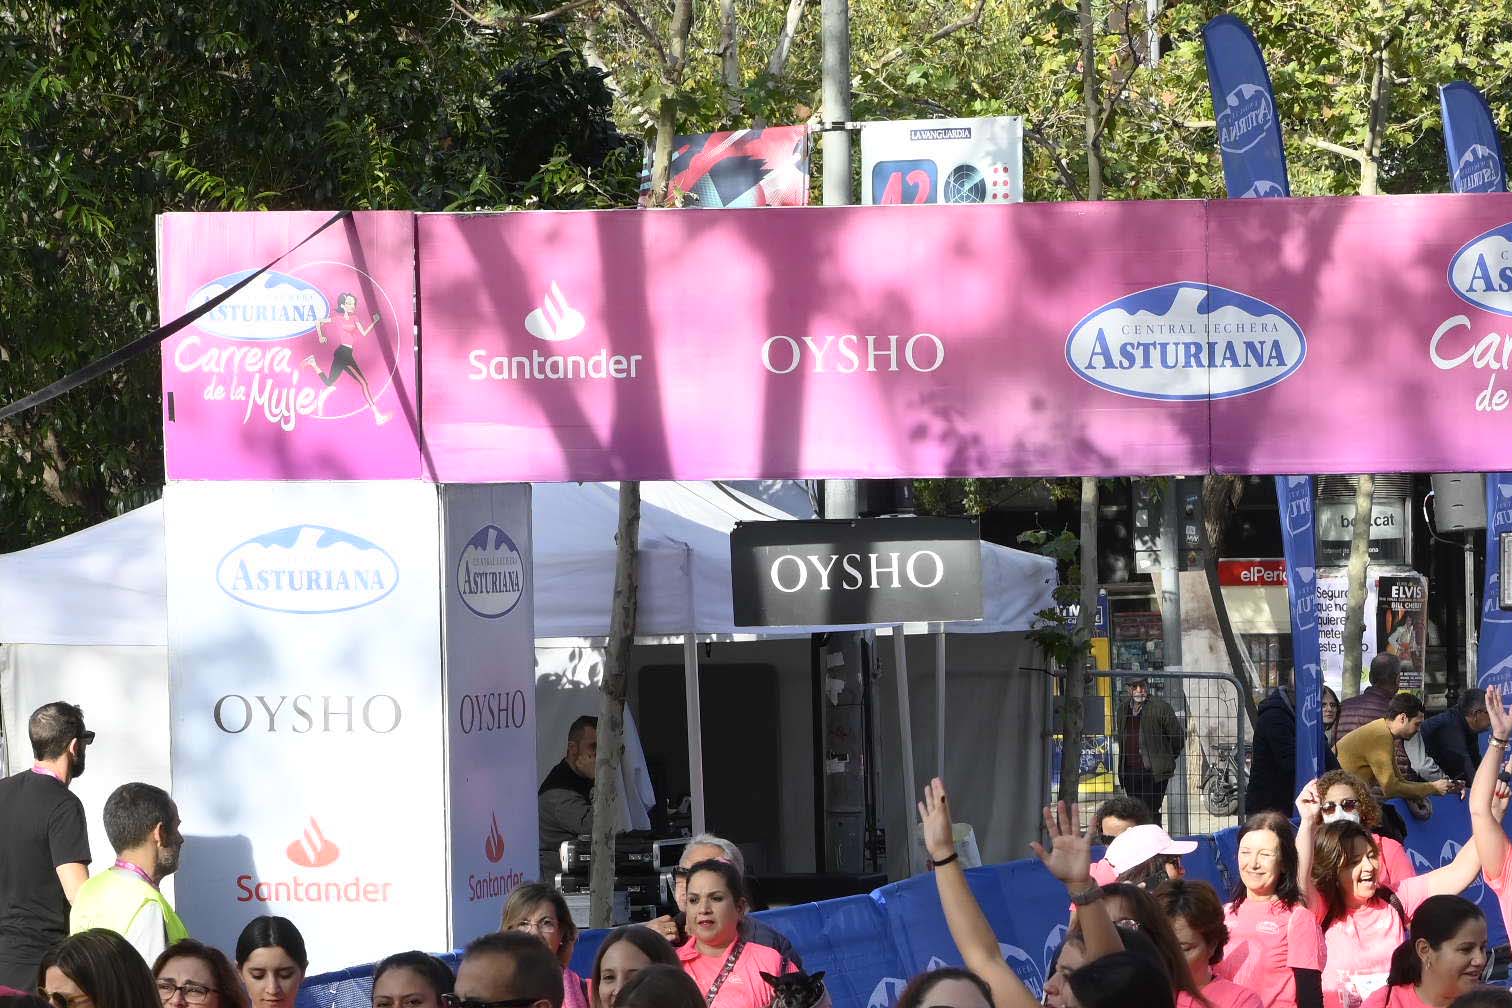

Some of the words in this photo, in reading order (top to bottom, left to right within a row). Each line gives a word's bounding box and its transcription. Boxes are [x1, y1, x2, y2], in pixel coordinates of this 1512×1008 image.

[922, 129, 971, 140] VANGUARDIA
[1122, 321, 1199, 335] CENTRAL
[1205, 320, 1279, 334] LECHERA
[174, 337, 292, 374] Carrera
[469, 349, 642, 380] Santander
[761, 333, 945, 374] OYSHO
[1086, 326, 1287, 370] ASTURIANA
[203, 378, 226, 402] de
[229, 375, 246, 402] la
[244, 370, 337, 431] Mujer
[1475, 373, 1509, 412] de
[1340, 513, 1396, 528] b.cat
[231, 559, 385, 592] ASTURIANA
[462, 564, 520, 595] ASTURIANA
[770, 549, 945, 593] OYSHO
[1392, 586, 1423, 599] ELVIS
[213, 694, 402, 734] OYSHO
[460, 689, 527, 734] OYSHO
[236, 874, 392, 903] Santander
